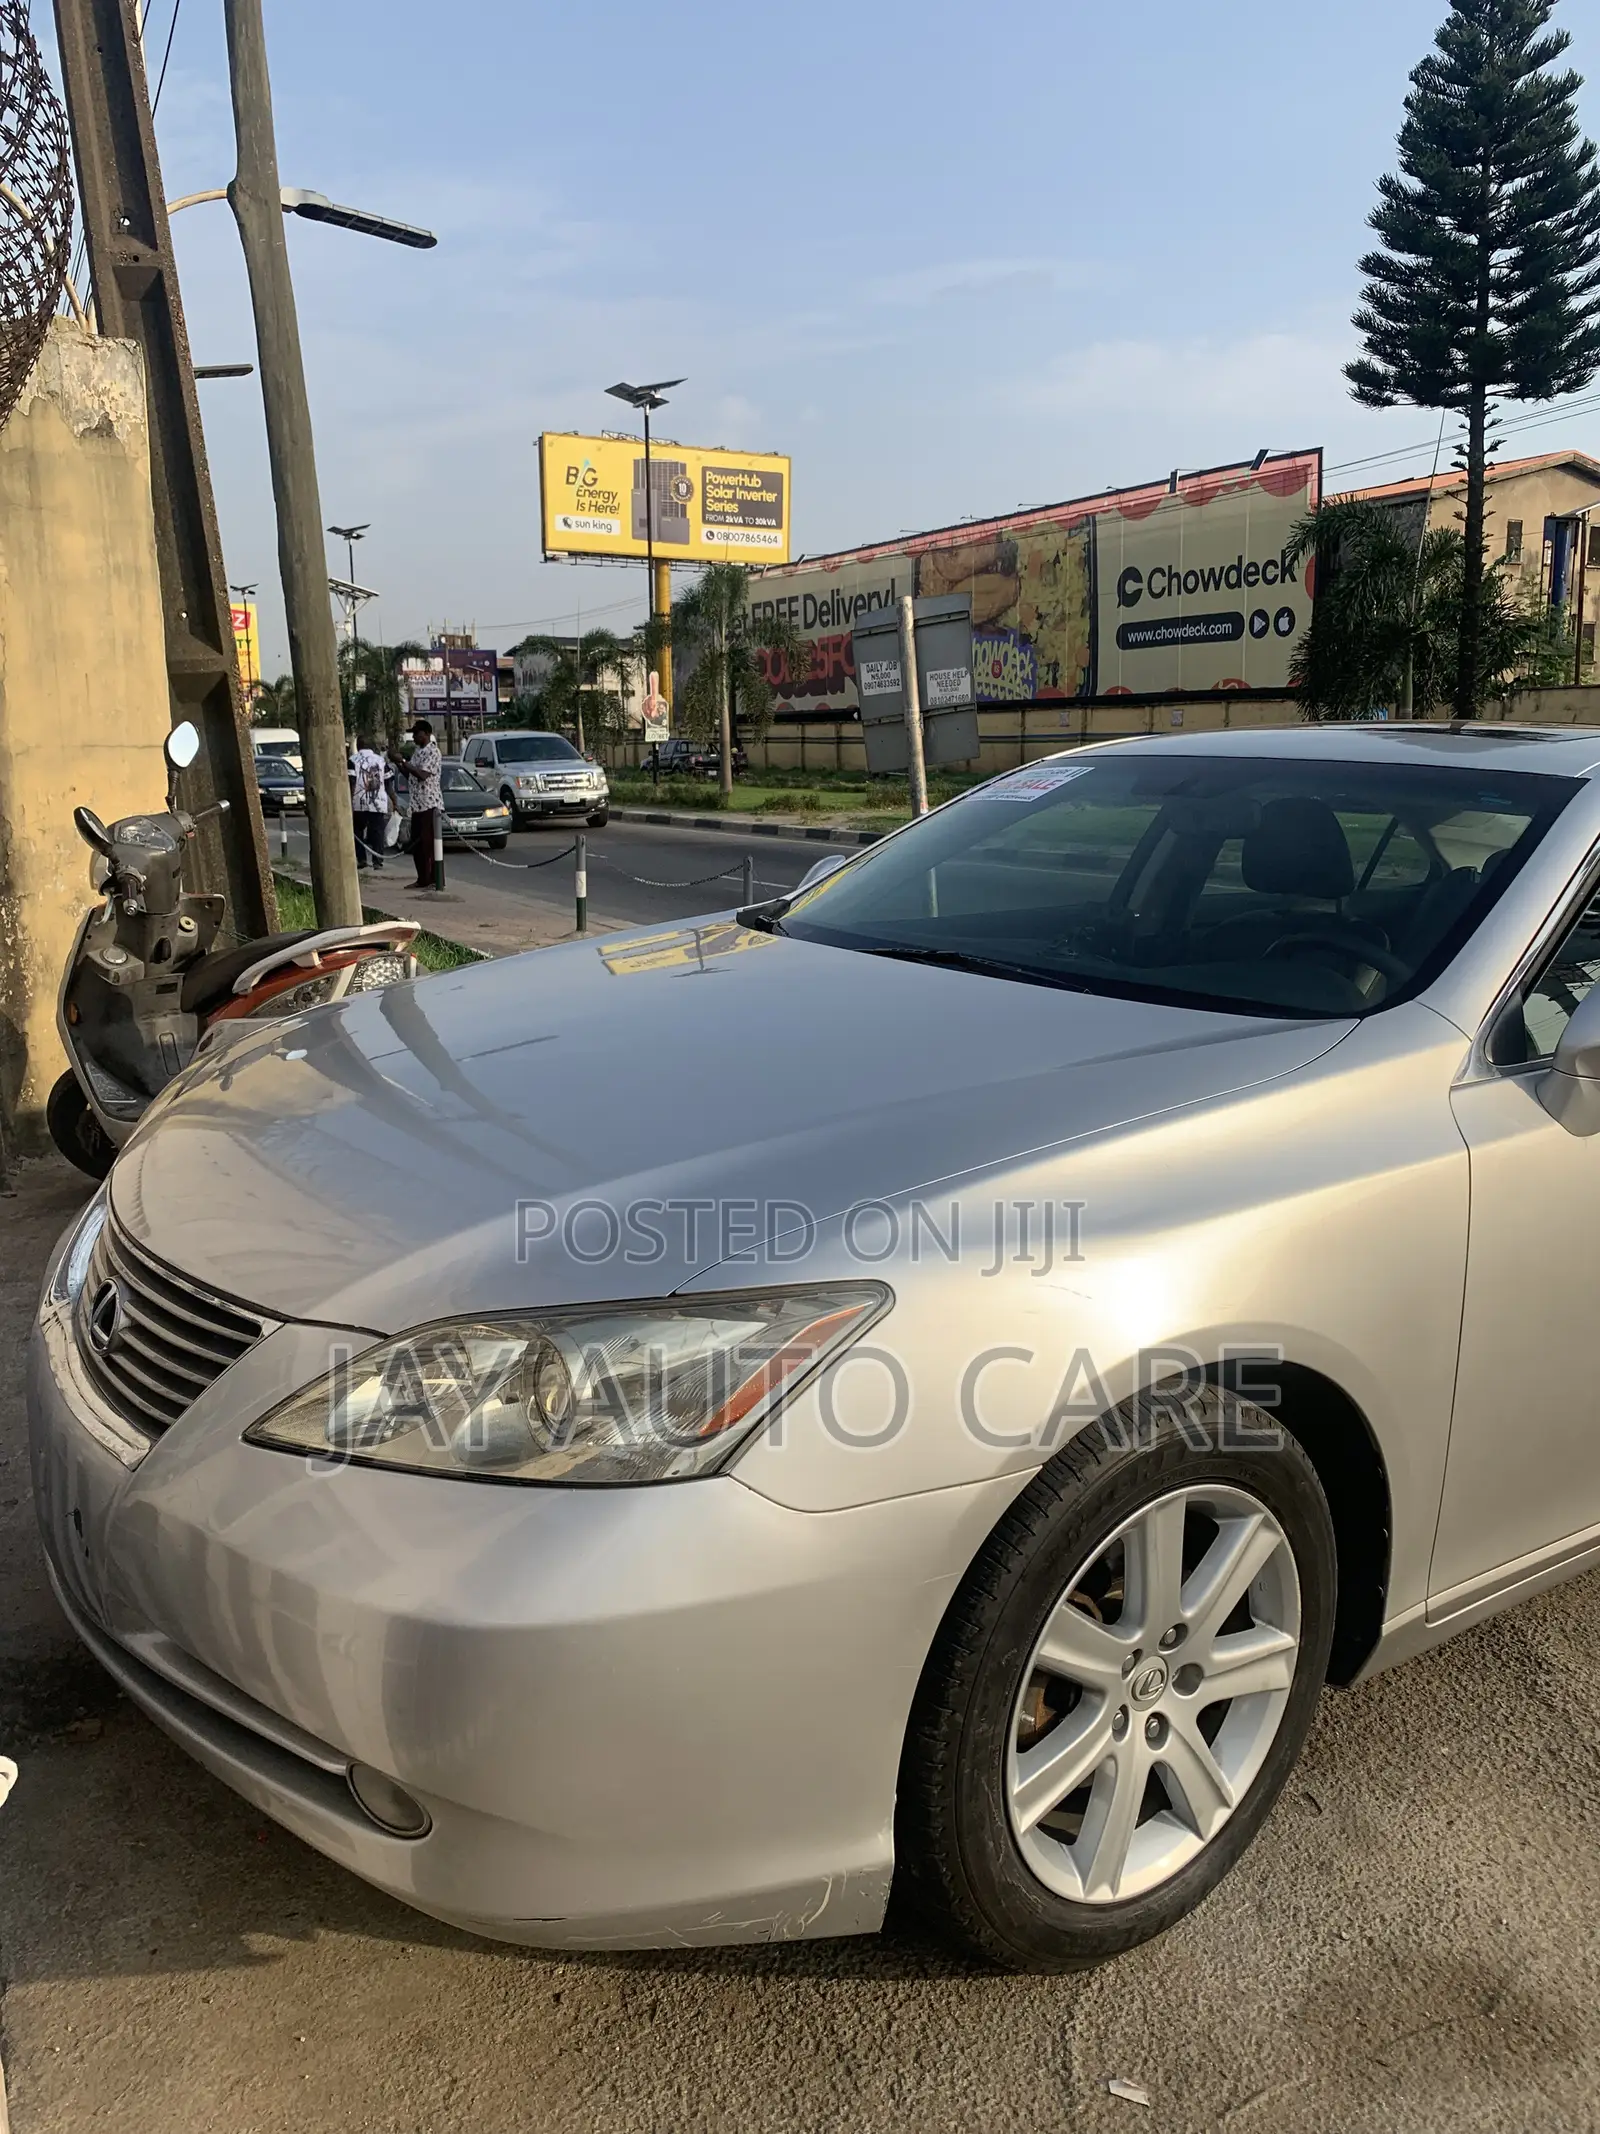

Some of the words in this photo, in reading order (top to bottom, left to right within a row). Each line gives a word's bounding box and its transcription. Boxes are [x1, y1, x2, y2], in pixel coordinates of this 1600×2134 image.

[705, 471, 762, 488] PowerHub
[576, 485, 618, 504] Energy
[705, 485, 735, 499] Solar
[736, 487, 778, 502] Inverter
[576, 498, 586, 512] Is
[587, 500, 620, 515] Here!
[705, 499, 739, 513] Series
[705, 514, 725, 523] FROM
[725, 515, 744, 524] 2kVA
[745, 517, 754, 525] TO
[574, 520, 590, 529] sun
[592, 520, 613, 534] king
[716, 531, 778, 544] 08007865464
[1147, 548, 1298, 600] Chowdeck
[1127, 622, 1233, 644] www.chowdeck.com
[866, 662, 883, 674] DAILY
[885, 661, 898, 671] JOB
[929, 671, 951, 681] HOUSE
[952, 670, 969, 679] HELP
[936, 678, 961, 688] NEEDED
